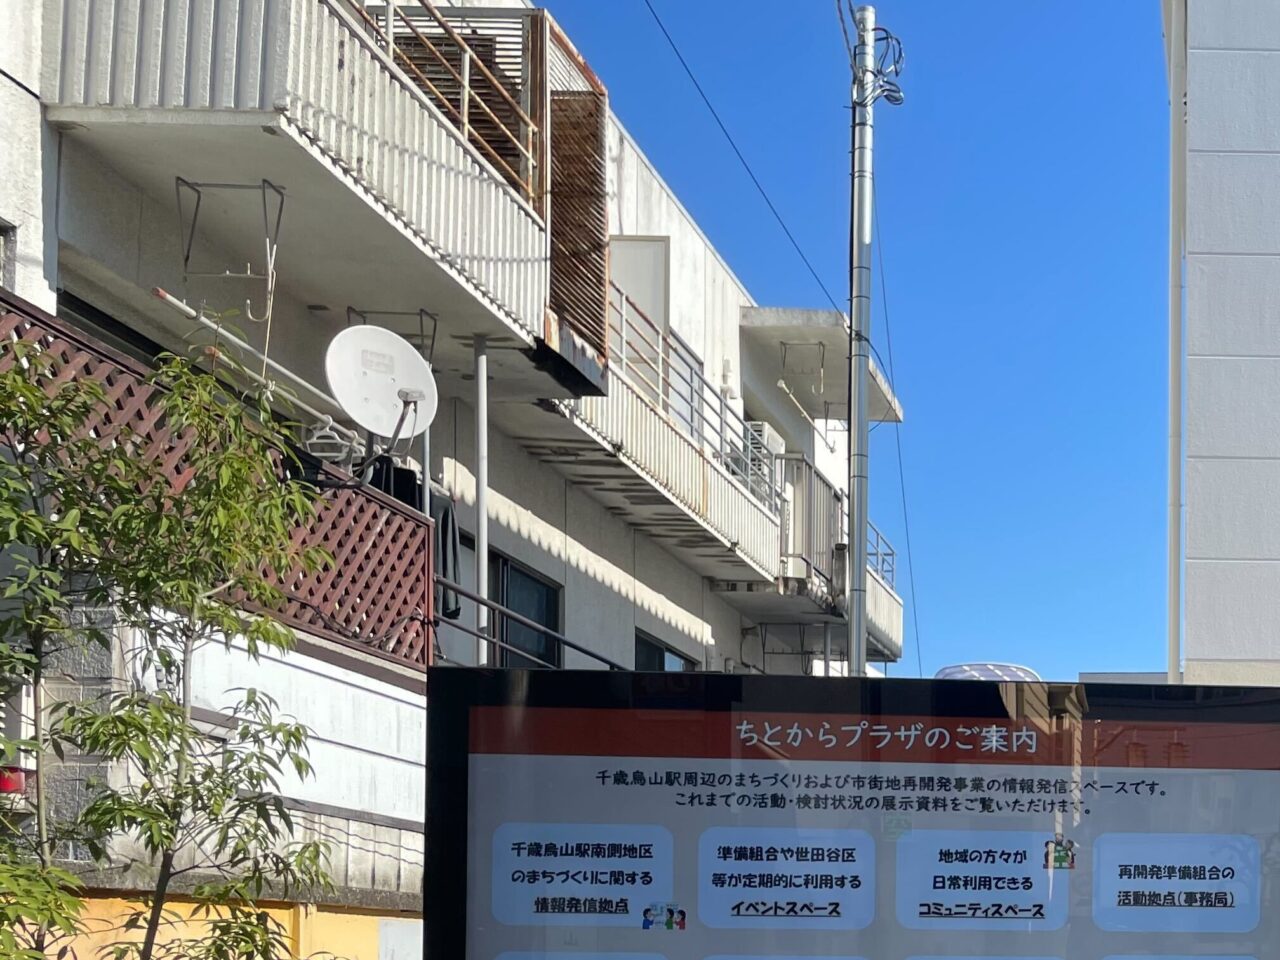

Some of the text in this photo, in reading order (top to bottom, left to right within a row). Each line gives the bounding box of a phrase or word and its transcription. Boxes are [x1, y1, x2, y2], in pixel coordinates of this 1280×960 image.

[735, 719, 1038, 754] ちとからプラザのご案内
[510, 841, 654, 859] 千歳烏山駅南側地区
[716, 844, 857, 862] 準備組合や世田谷区
[938, 848, 1028, 864] 地域の方々が
[511, 869, 653, 885] のまちづくりに関する
[1118, 864, 1235, 880] 再開発準備組合の
[711, 872, 862, 889] 等が定期的に利用する
[932, 875, 1034, 891] 日常利用できる
[533, 896, 630, 914] 情報発信拠点
[730, 901, 841, 917] イベントスペース
[918, 902, 1045, 918] コミュニティスペース
